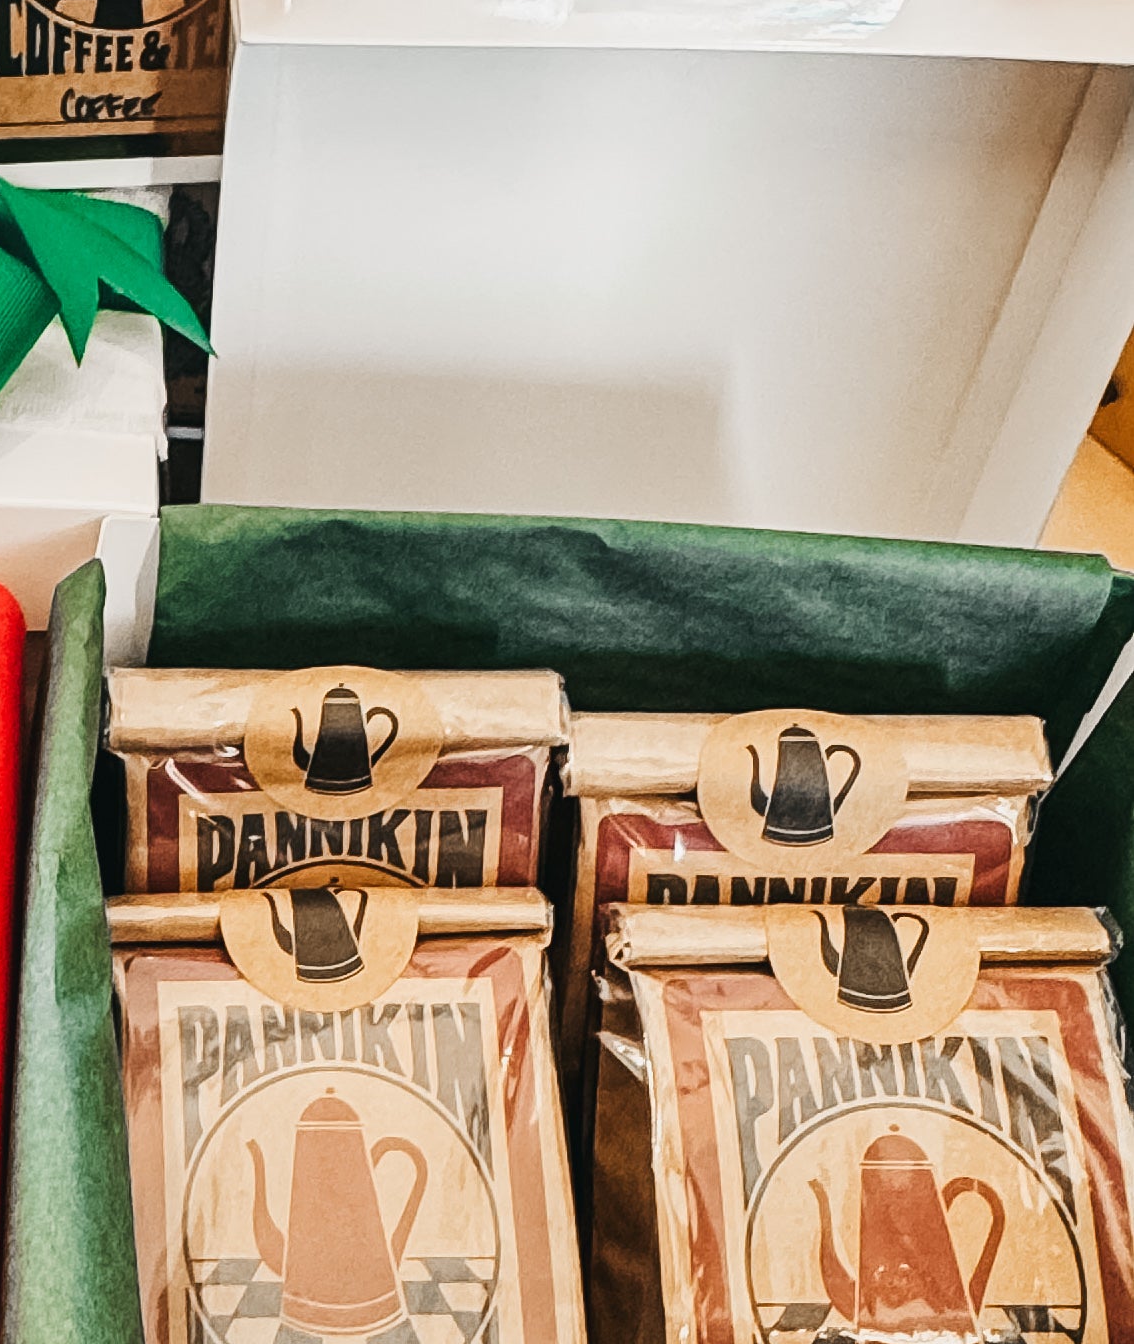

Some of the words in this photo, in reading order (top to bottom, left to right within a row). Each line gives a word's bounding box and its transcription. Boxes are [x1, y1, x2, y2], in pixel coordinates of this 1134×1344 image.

[196, 808, 488, 891] PANNIKIN
[647, 873, 958, 905] ANNIKI
[177, 1002, 494, 1182] PANNIKIN
[725, 1035, 1078, 1227] PANNIKIN
